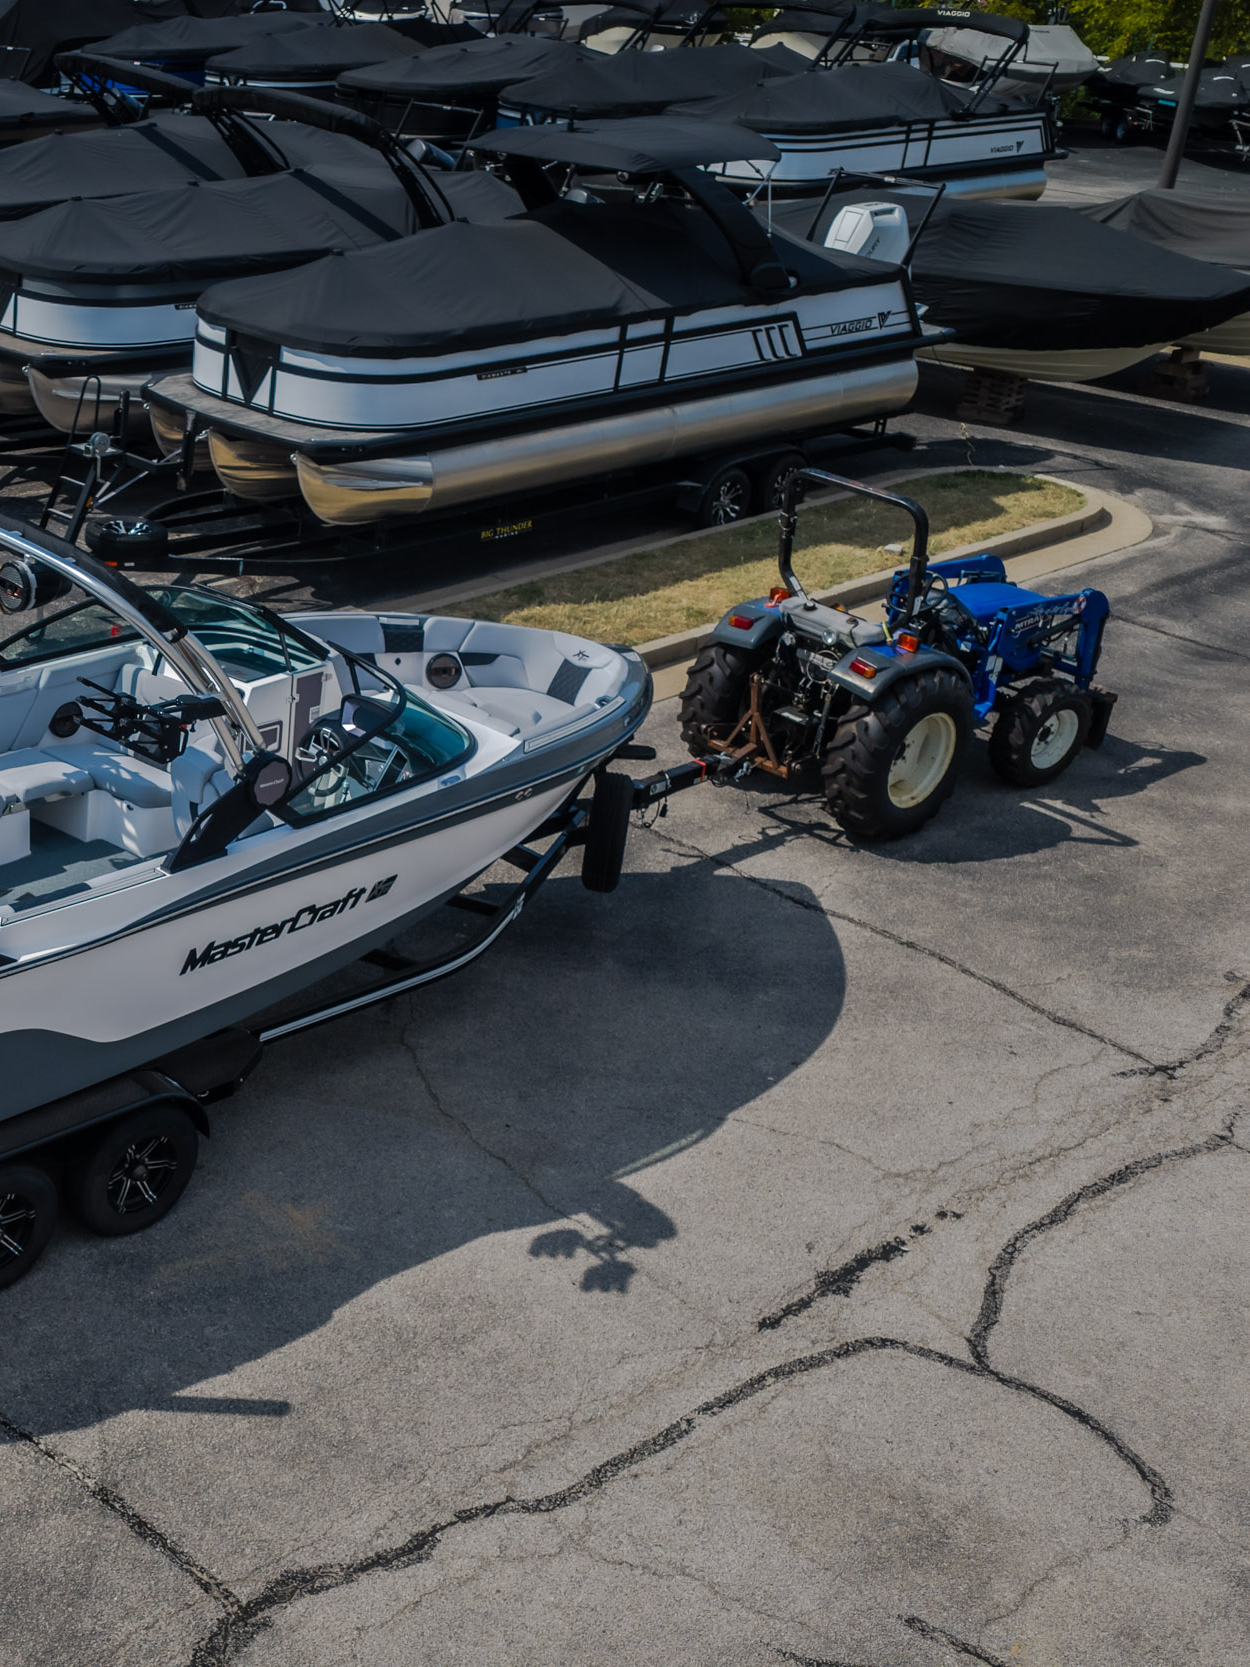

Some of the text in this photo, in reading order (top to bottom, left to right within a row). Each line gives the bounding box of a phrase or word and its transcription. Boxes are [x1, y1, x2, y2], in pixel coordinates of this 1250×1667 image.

[937, 9, 971, 18] VIAGGIO
[990, 144, 1015, 153] VIAGGIO
[830, 319, 873, 336] VIAGGIO
[481, 520, 533, 540] BIG THUNDER
[179, 887, 367, 976] MasterCraft
